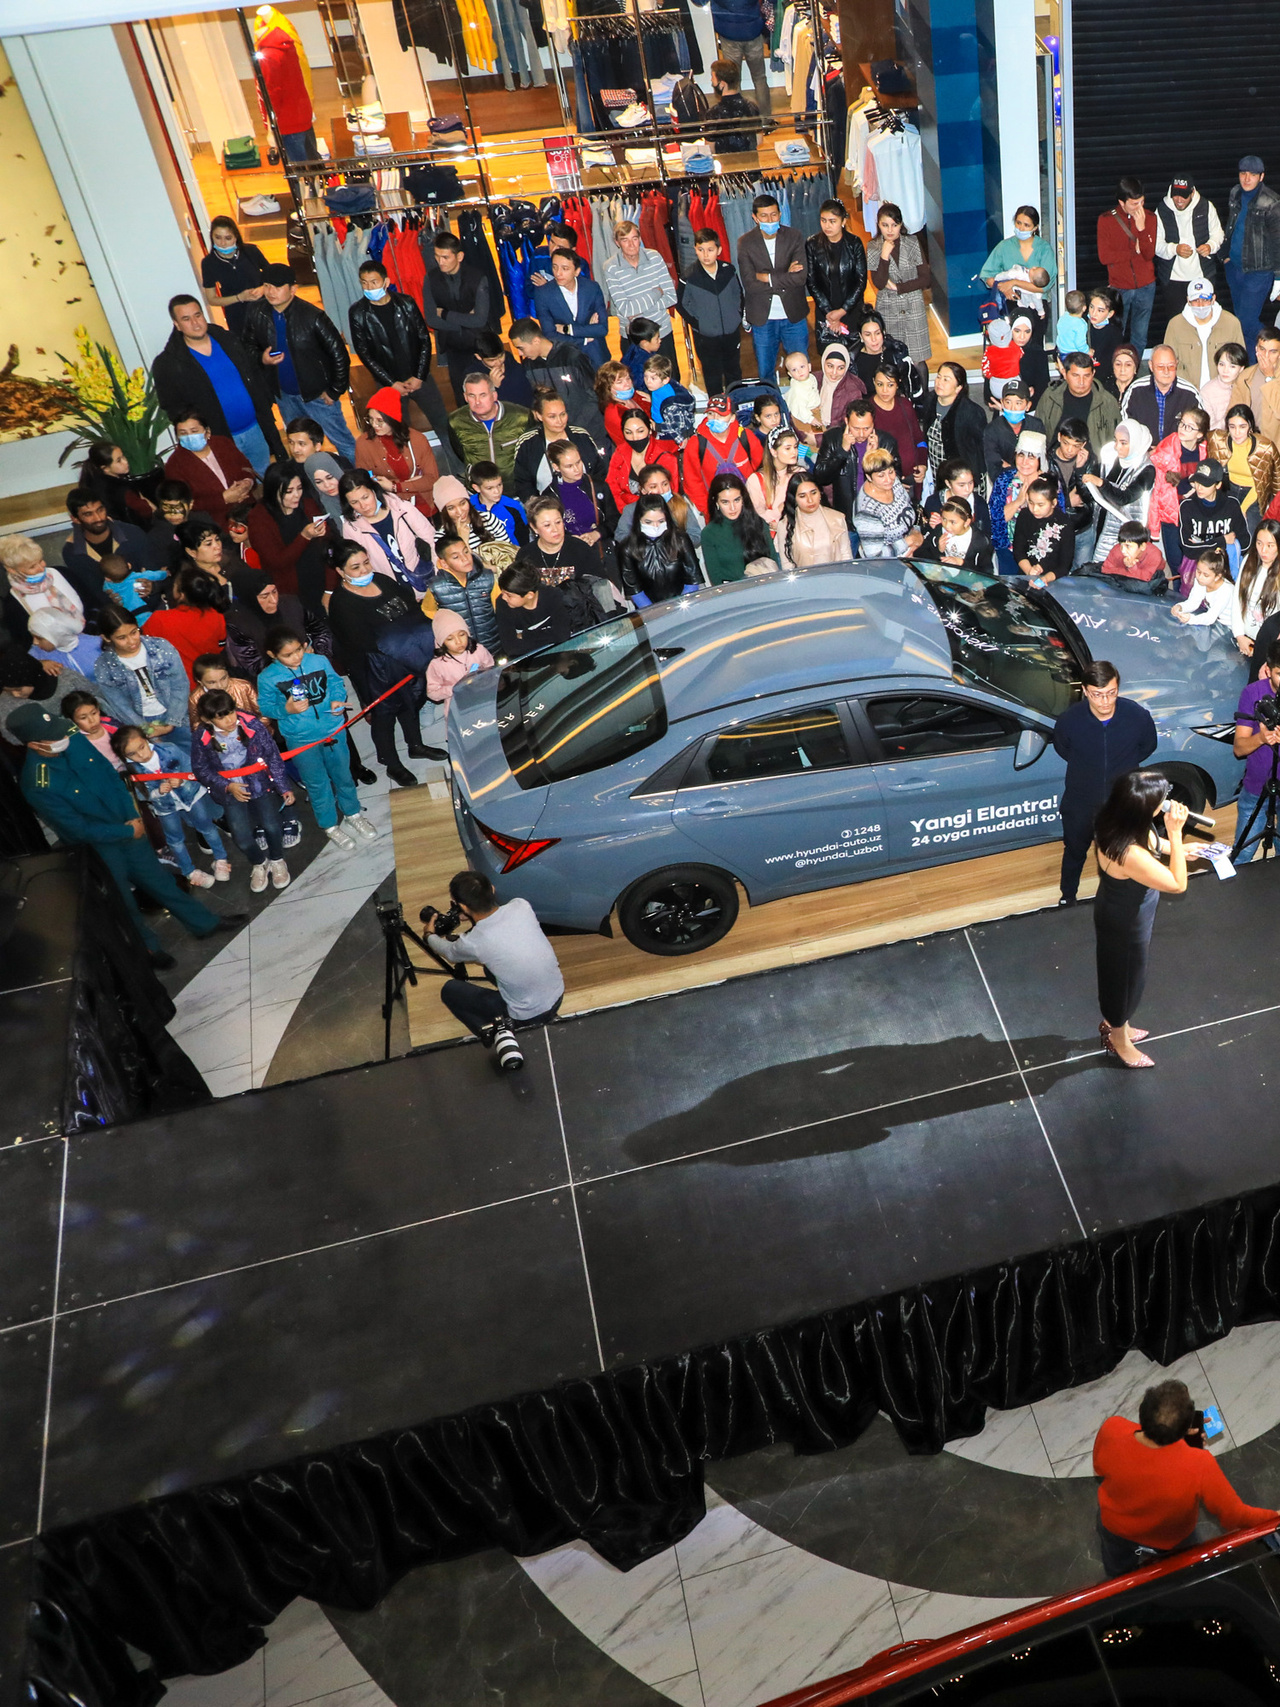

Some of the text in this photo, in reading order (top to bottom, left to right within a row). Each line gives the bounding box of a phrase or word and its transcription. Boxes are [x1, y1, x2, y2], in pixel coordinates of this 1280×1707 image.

[553, 154, 569, 163] OFF
[1191, 518, 1232, 536] BLACK
[910, 795, 1058, 833] Yangi Elantra!
[854, 824, 881, 836] 1248
[911, 836, 930, 847] 24
[932, 828, 970, 843] oyga
[973, 815, 1038, 835] muddatli
[765, 835, 882, 864] www.hyundai-auto.uz
[795, 844, 884, 868] @hyundai_uzbot
